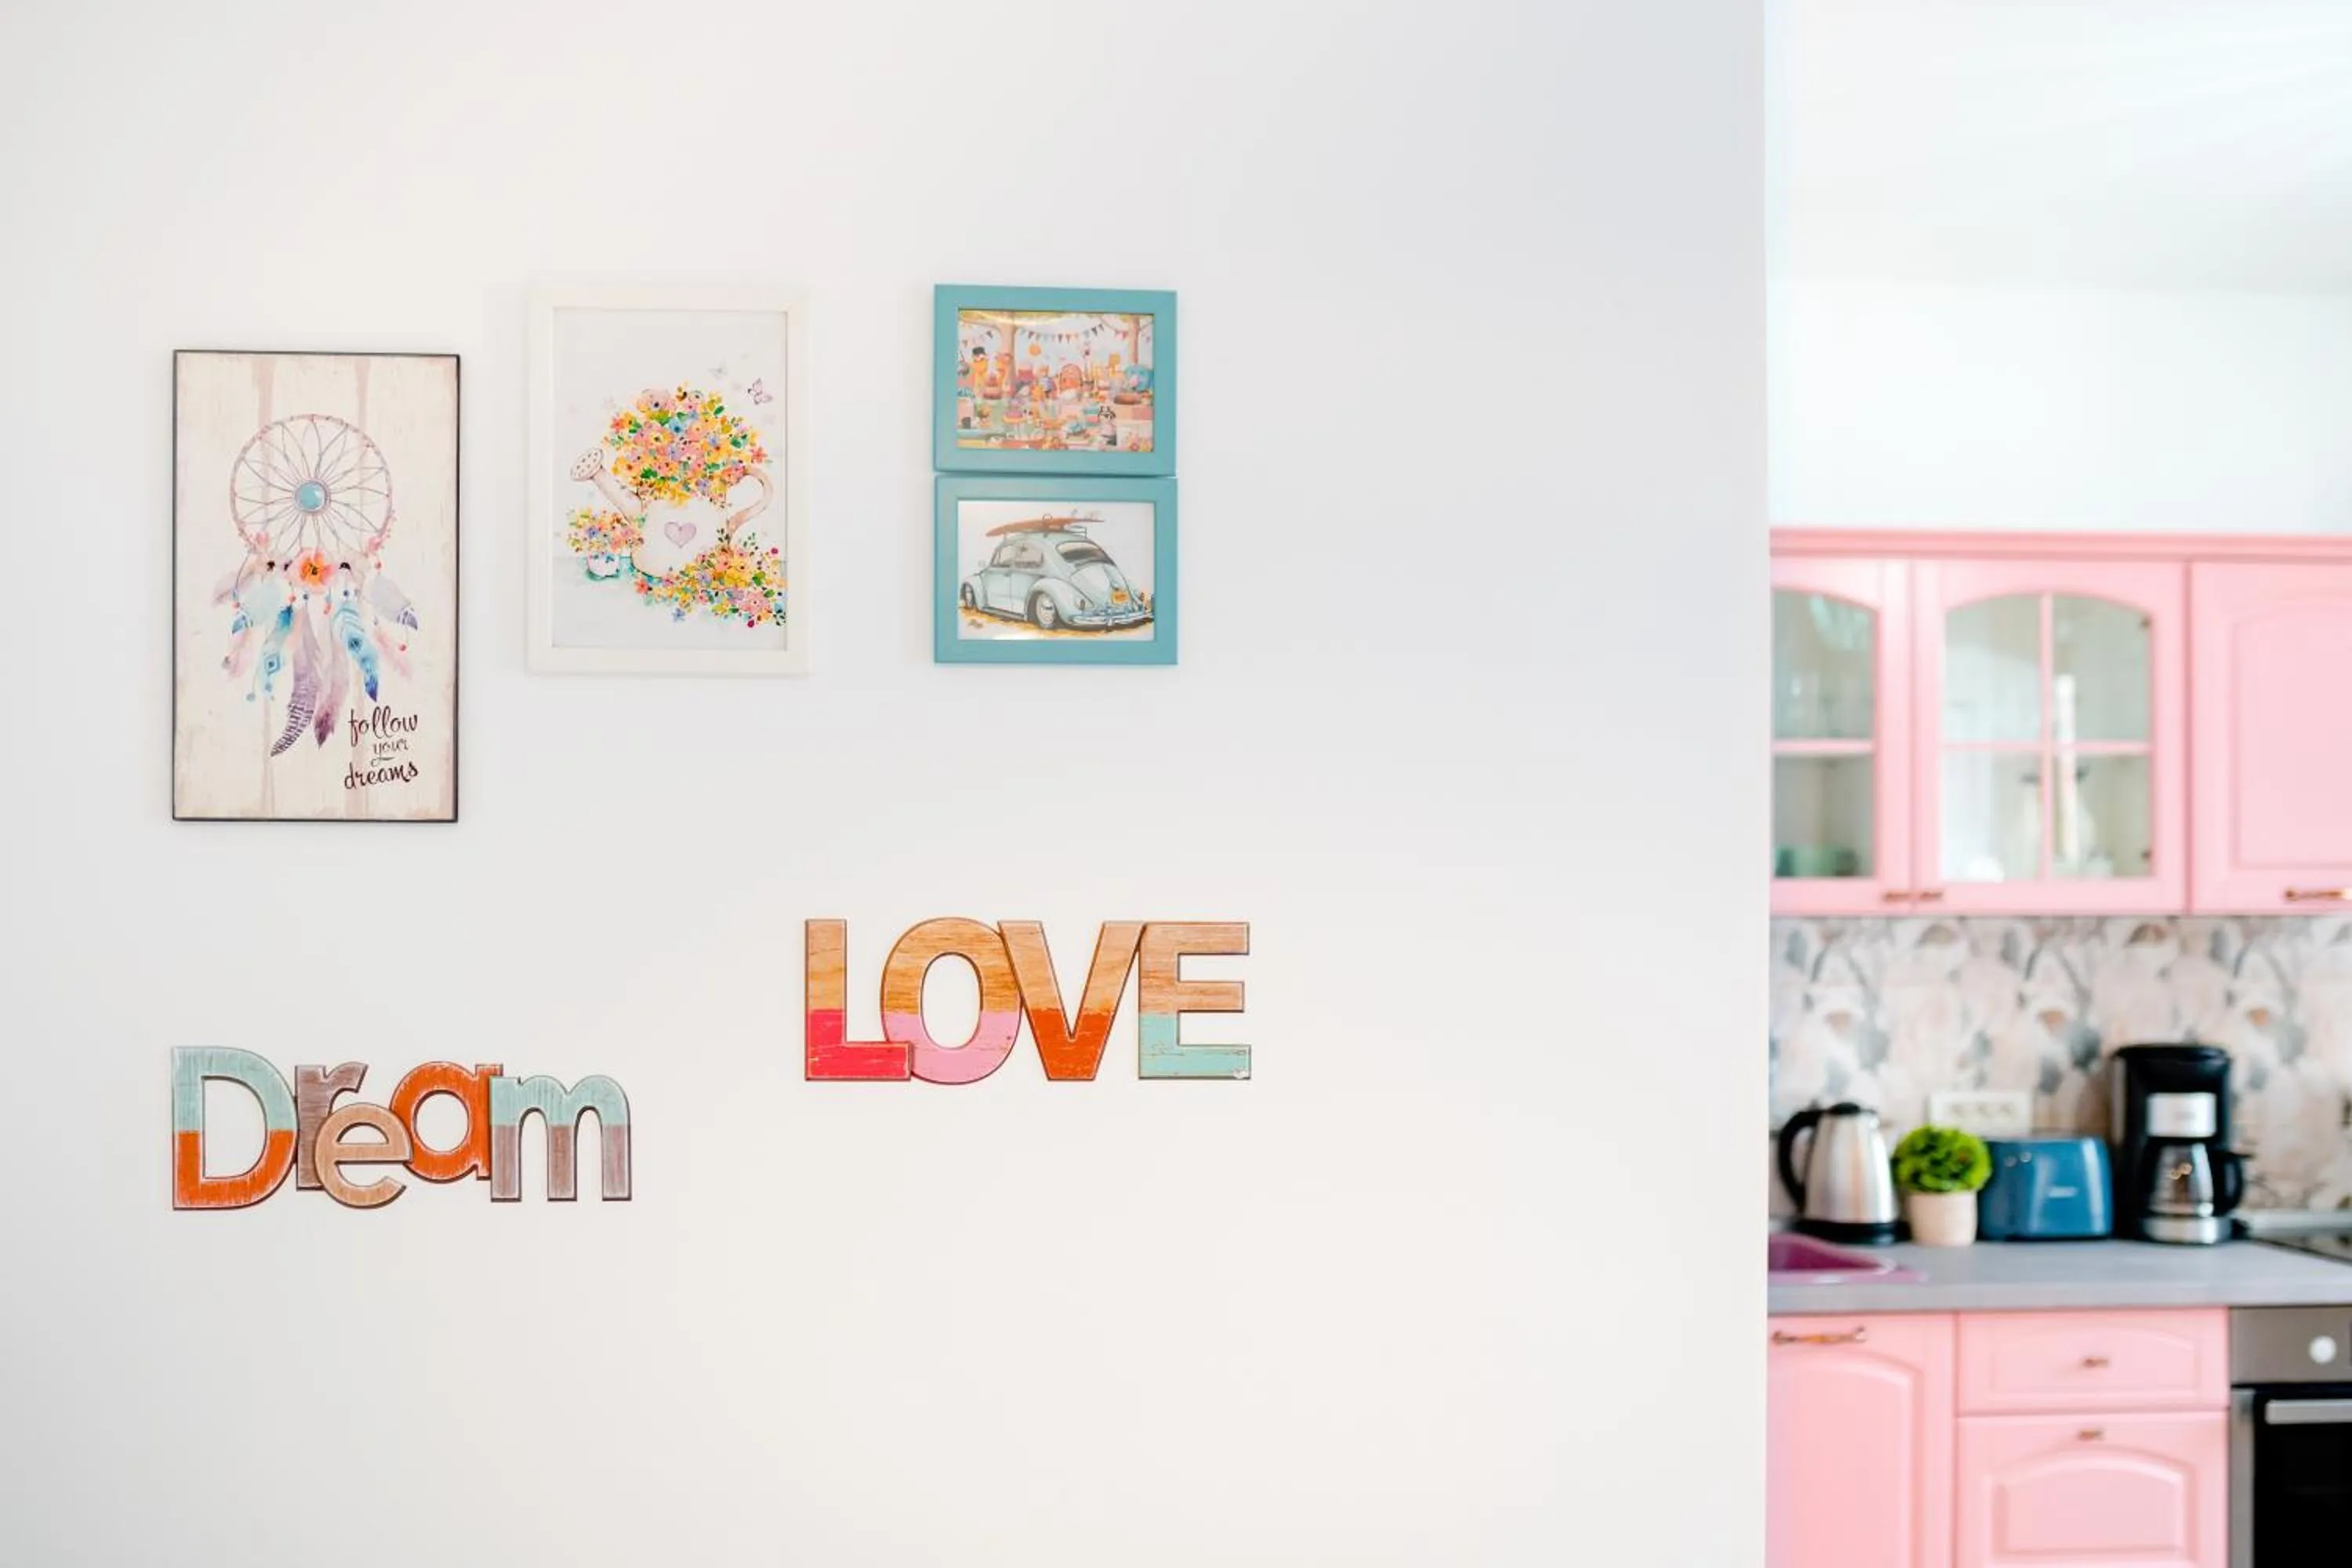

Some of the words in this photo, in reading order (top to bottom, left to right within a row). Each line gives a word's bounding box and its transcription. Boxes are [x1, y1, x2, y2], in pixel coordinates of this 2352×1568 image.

[348, 705, 418, 747] follow
[371, 738, 408, 767] your
[344, 761, 419, 789] dreams
[804, 916, 1252, 1085] LOVE
[171, 1045, 633, 1210] Dream
